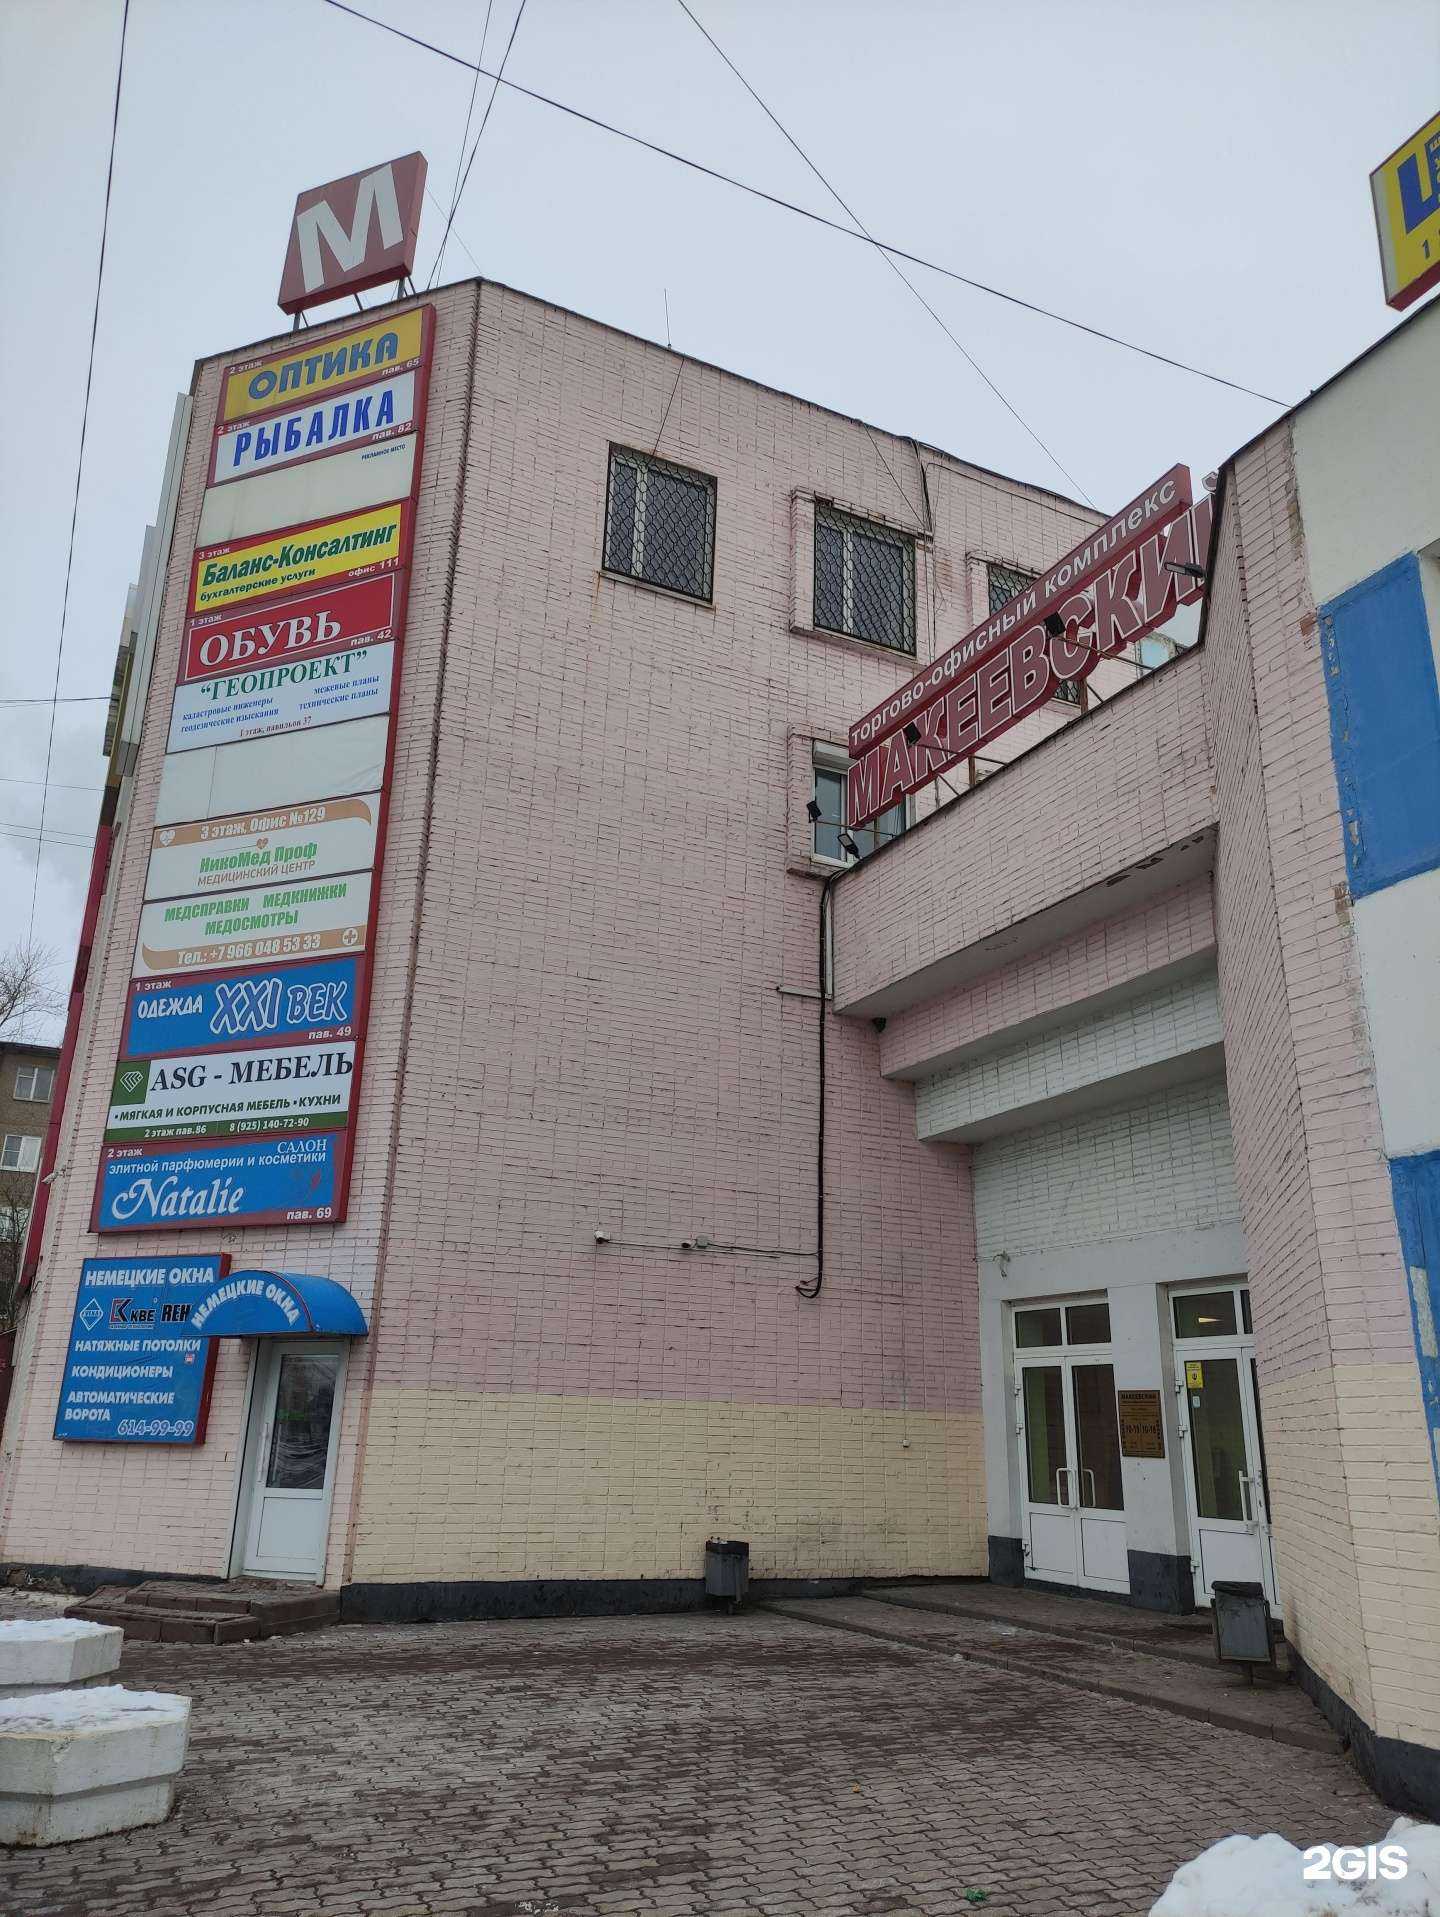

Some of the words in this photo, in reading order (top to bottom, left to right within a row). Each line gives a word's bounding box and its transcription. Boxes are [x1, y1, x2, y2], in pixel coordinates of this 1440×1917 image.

[297, 163, 404, 293] М
[248, 331, 399, 400] ОПТИКА
[406, 356, 420, 368] 65
[217, 424, 224, 435] 2
[226, 420, 250, 432] этаж
[233, 389, 394, 467] РЫБАЛКА
[397, 422, 412, 435] 82
[1044, 480, 1176, 598] комплекс
[199, 551, 206, 560] 3
[207, 547, 230, 558] этаж
[202, 523, 397, 587] Баланс-Консалтинг
[348, 564, 376, 578] офис
[379, 557, 400, 571] 111
[200, 578, 278, 602] бухгалтерские
[280, 567, 316, 586] услуги
[190, 617, 196, 627] 1
[197, 613, 223, 625] этаж
[200, 610, 342, 667] ОБУВЬ
[350, 635, 374, 647] пав.
[377, 628, 392, 640] 42
[313, 680, 351, 695] межевые
[351, 674, 380, 688] планы
[299, 694, 350, 711] технические
[350, 687, 379, 701] планы
[235, 707, 280, 723] изыскания
[200, 825, 208, 840] 3
[249, 814, 287, 832] Офис
[289, 807, 326, 825] №129
[200, 850, 271, 873] НикоМед
[274, 841, 318, 862] Проф
[198, 863, 278, 887] МЕДИЦИНСКИЙ
[281, 860, 316, 876] ЦЕНТР
[164, 897, 250, 922] МЕДСПРАВКИ
[262, 883, 348, 909] МЕДКНИЖКИ
[204, 910, 299, 936] МЕДОСМОТРЫ
[135, 982, 141, 992] 1
[143, 979, 172, 991] этаж
[137, 994, 203, 1019] ОДЕЖДА
[210, 977, 283, 1035] XXI
[286, 980, 348, 1024] ВЕК
[308, 1029, 333, 1040] пав.
[336, 1026, 352, 1036] 49
[150, 1065, 206, 1092] ASG
[229, 1051, 353, 1085] МЕБЕЛЬ
[119, 1108, 163, 1121] МЯГКАЯ
[165, 1107, 174, 1118] И
[176, 1100, 244, 1117] КОРПУСНАЯ
[246, 1097, 291, 1112] МЕБЕЛЬ
[298, 1093, 341, 1108] КУХНИ
[144, 1129, 151, 1138] 2
[151, 1127, 174, 1138] этаж
[237, 1119, 261, 1133] (925)
[262, 1117, 309, 1131] 140-72-90
[108, 1148, 115, 1158] 2
[116, 1147, 143, 1158] этаж
[277, 1138, 328, 1155] САЛОН
[109, 1160, 159, 1175] элитной
[161, 1157, 245, 1174] парфюмерии
[247, 1156, 256, 1166] и
[258, 1152, 326, 1166] косметики
[111, 1175, 246, 1221] Natalie
[286, 1209, 313, 1221] пав.
[316, 1207, 332, 1219] 69
[85, 1267, 167, 1288] НЕМЕЦКИЕ
[168, 1267, 214, 1285] ОКНА
[190, 1279, 265, 1330] НЕМЕЦКИЕ
[265, 1282, 300, 1327] ОКНА
[75, 1340, 140, 1352] НАТЯЖНЫЕ
[142, 1339, 202, 1351] ПОТОЛКИ
[71, 1365, 174, 1379] КОНДИЦИОНЕРЫ
[66, 1391, 175, 1405] АВТОМАТИЧЕСКИЕ
[64, 1408, 111, 1421] ВОРОТА
[117, 1419, 195, 1437] 614-99-99
